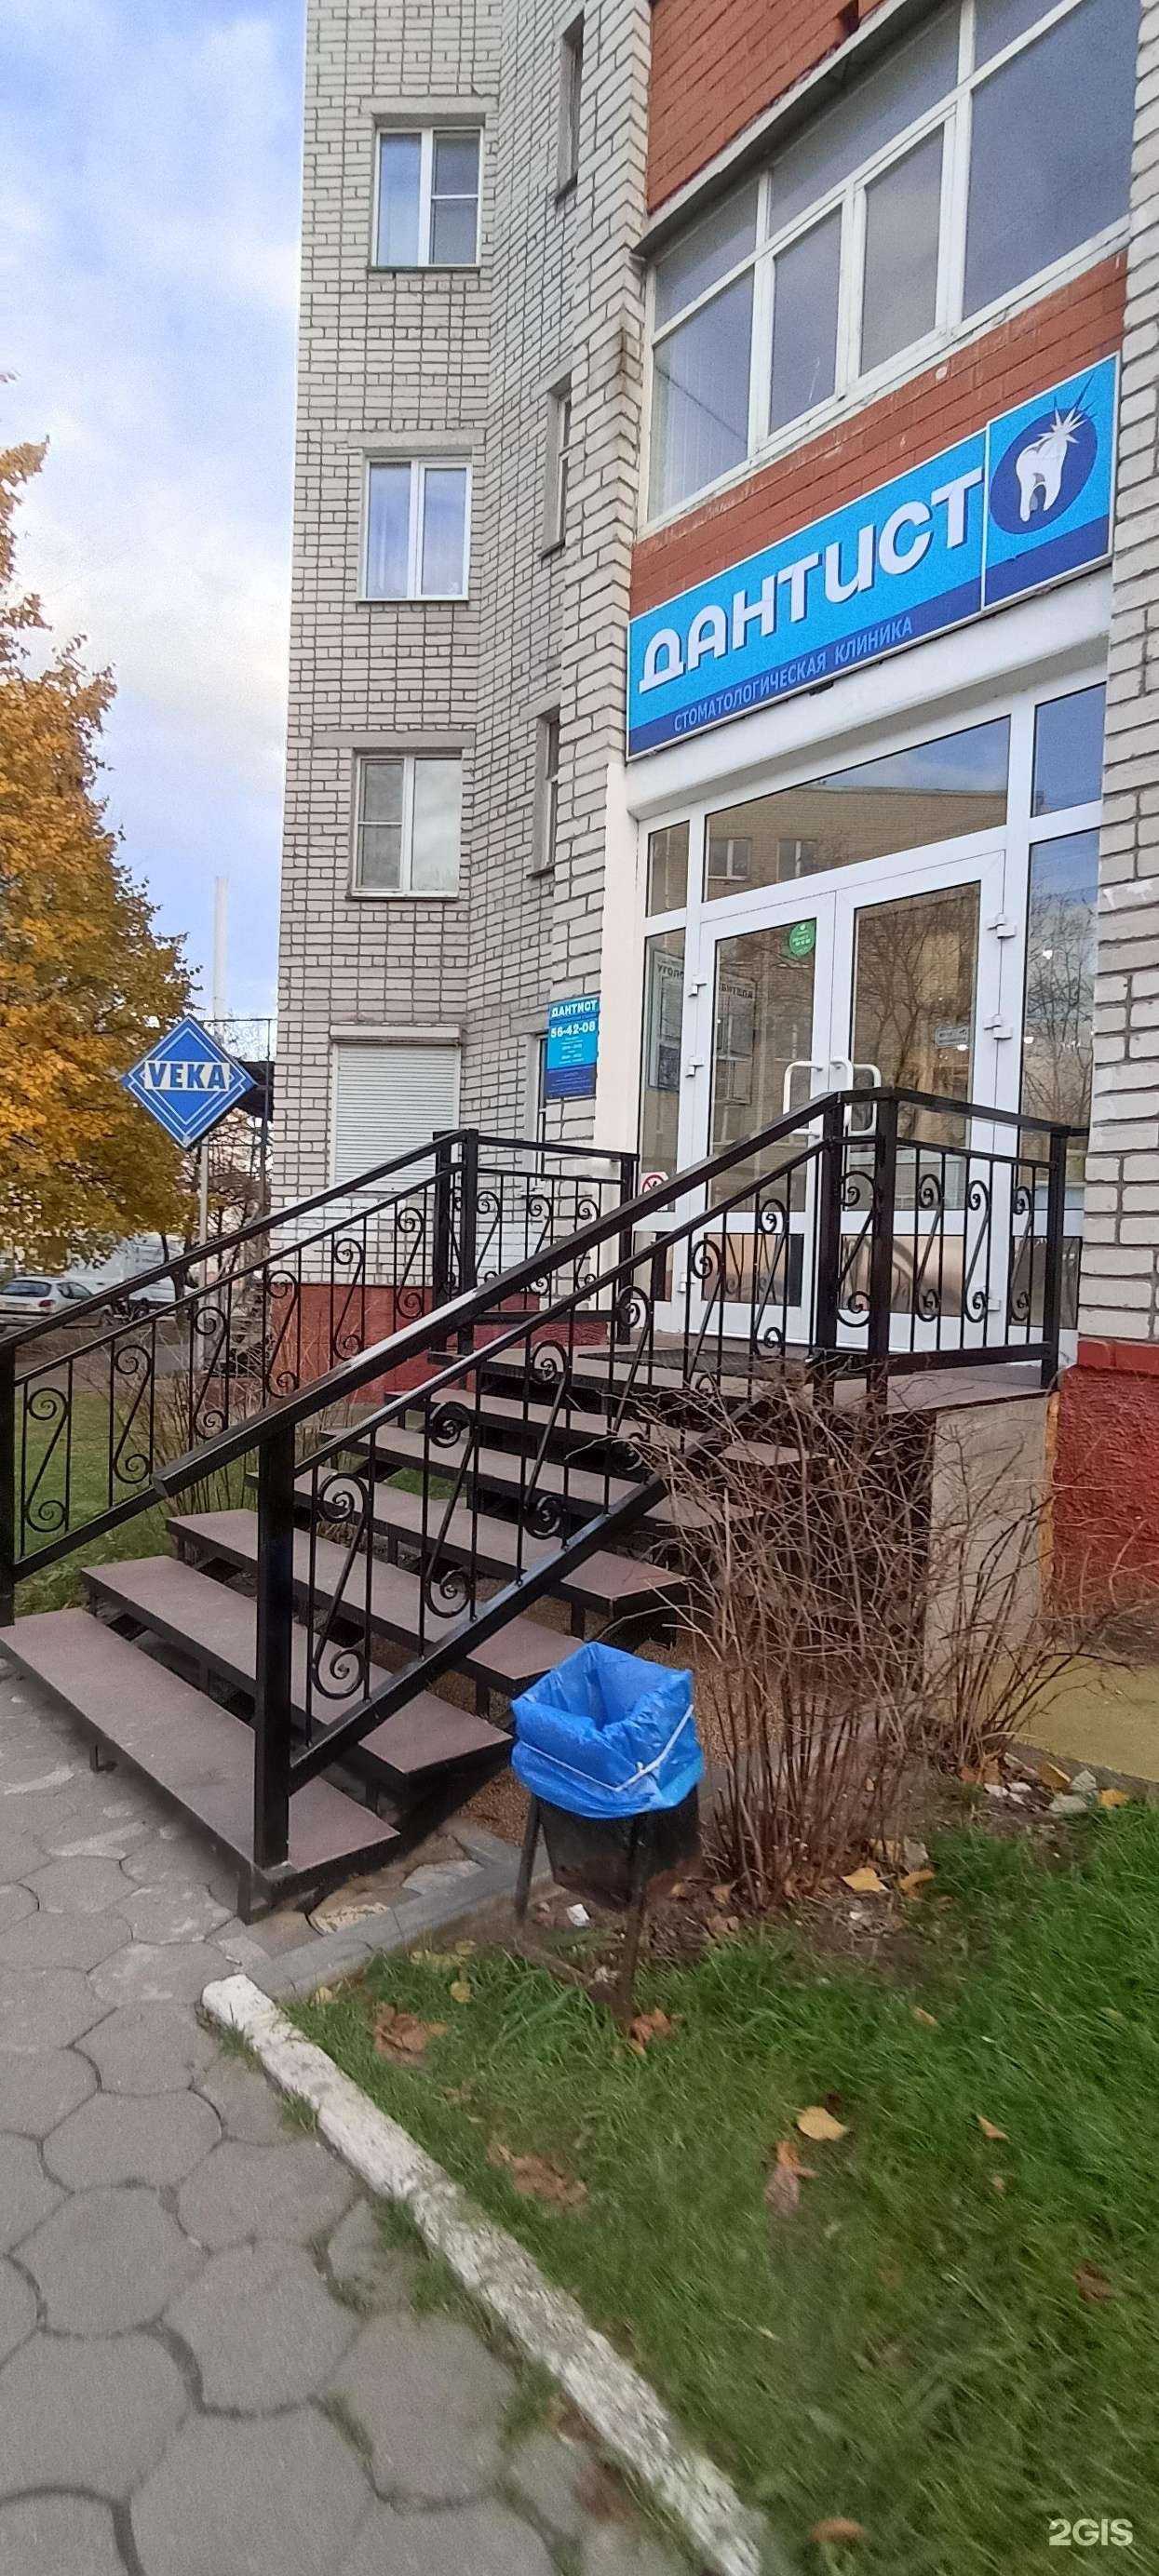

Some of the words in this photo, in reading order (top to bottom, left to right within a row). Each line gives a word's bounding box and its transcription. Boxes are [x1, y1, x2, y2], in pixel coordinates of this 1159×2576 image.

[639, 468, 984, 694] ДАНТИСТ
[674, 651, 827, 732] СТОМАТОЛОГИЧЕСКАЯ
[834, 616, 913, 665] КЛИНИКА
[657, 963, 684, 980] УГОЛО
[551, 1000, 598, 1017] ДАНТИСТ
[550, 1021, 596, 1039] 56-42-08
[148, 1063, 226, 1089] VEKA
